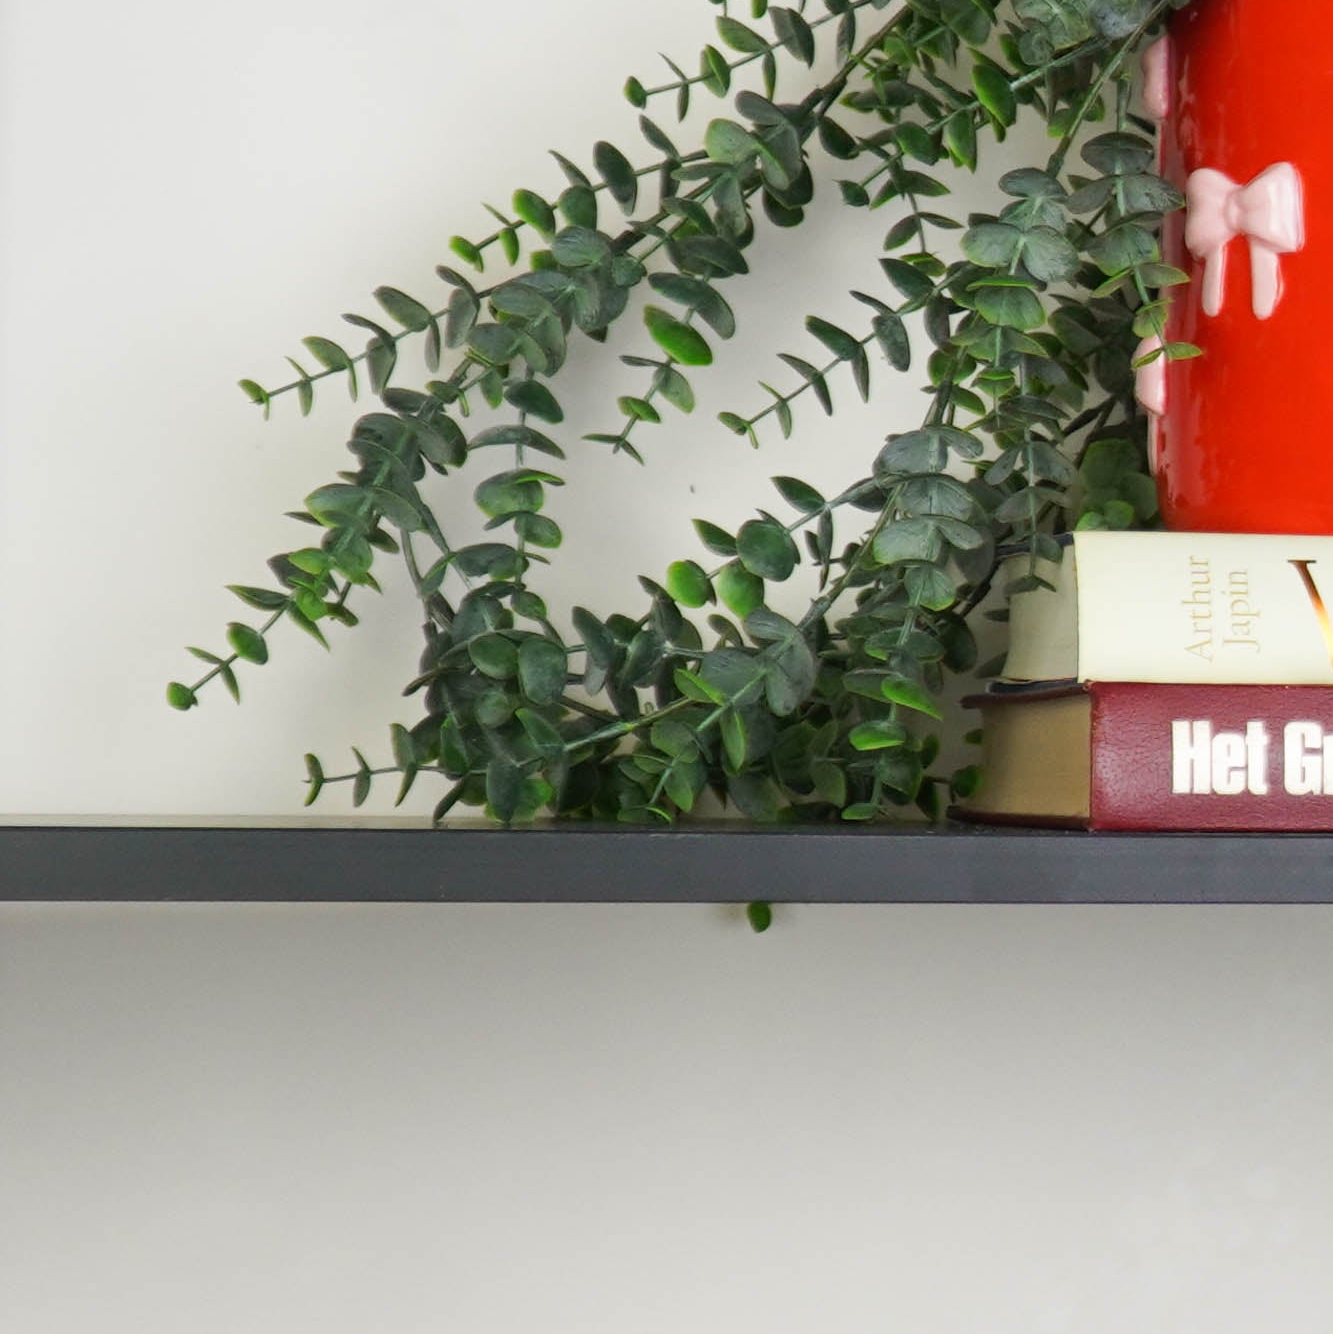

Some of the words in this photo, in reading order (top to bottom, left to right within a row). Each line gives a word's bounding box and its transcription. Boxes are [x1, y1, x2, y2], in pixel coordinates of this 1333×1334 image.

[1182, 555, 1215, 663] Arthur
[1222, 569, 1262, 654] Japin
[1171, 720, 1268, 796] Het
